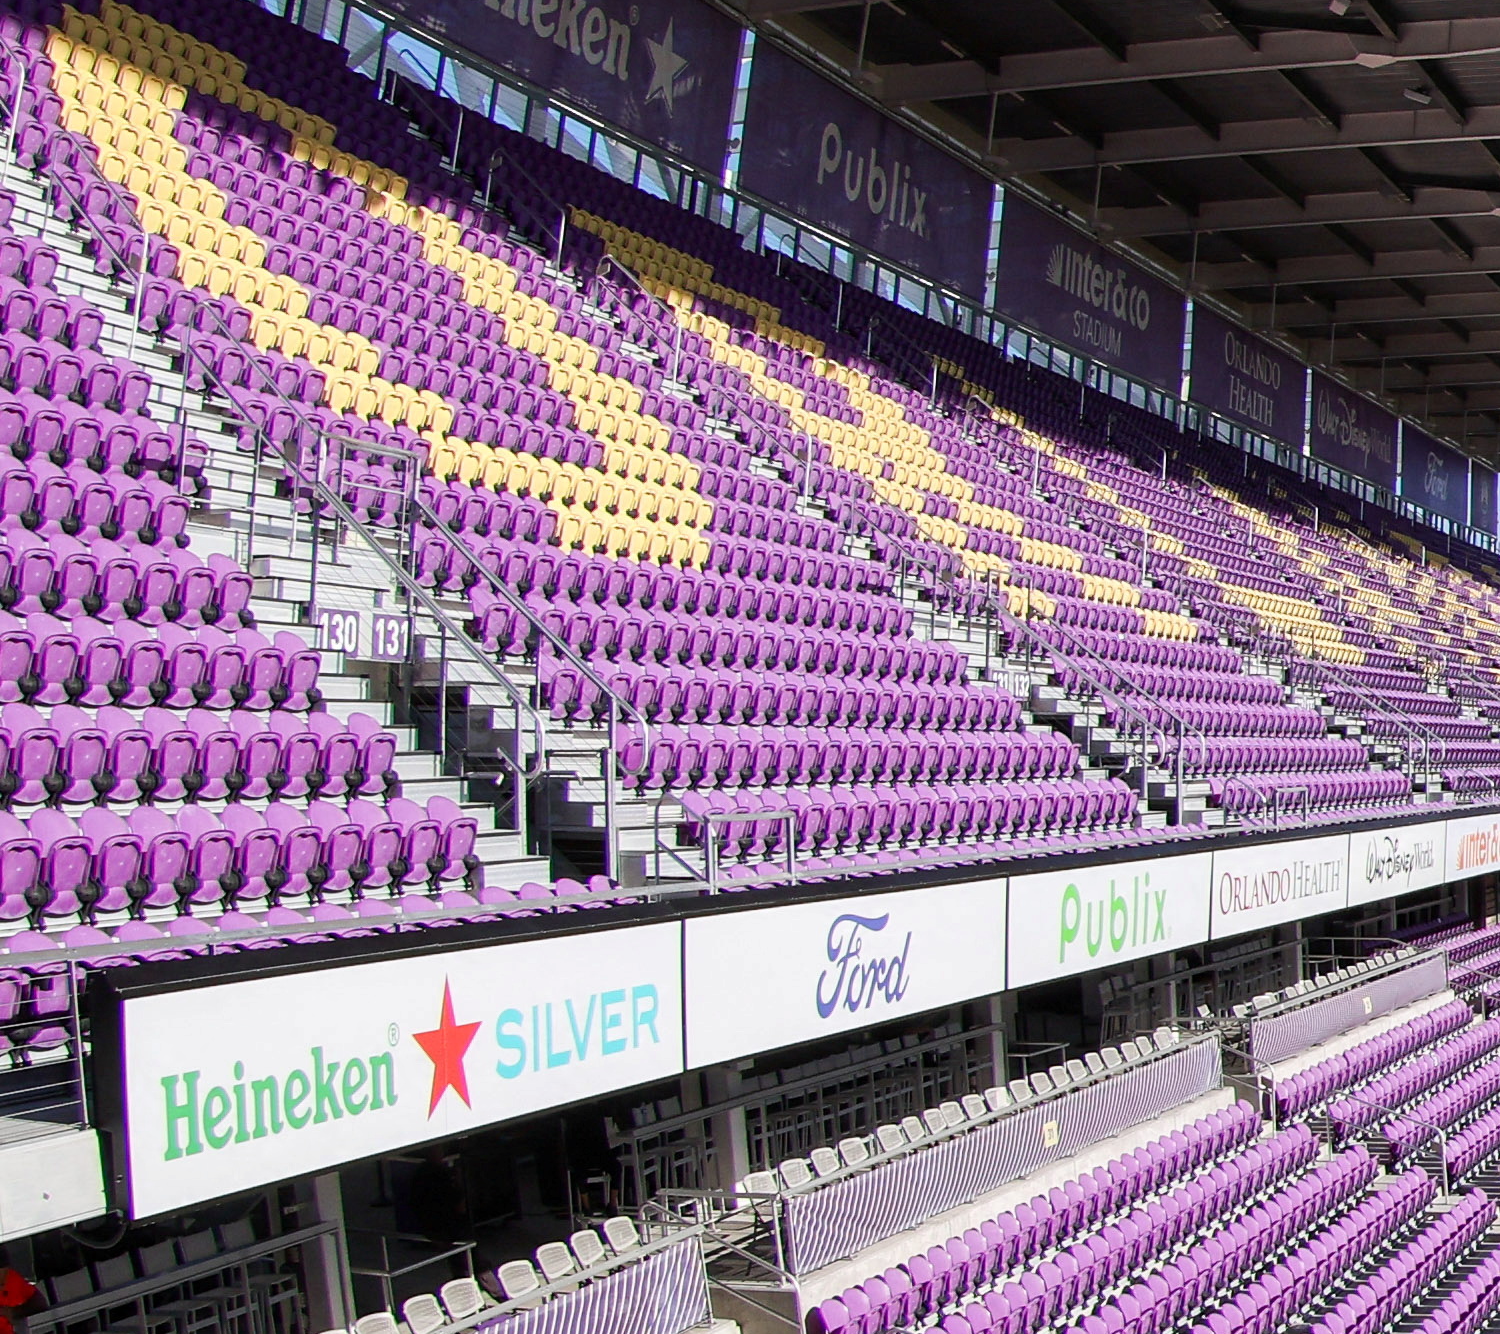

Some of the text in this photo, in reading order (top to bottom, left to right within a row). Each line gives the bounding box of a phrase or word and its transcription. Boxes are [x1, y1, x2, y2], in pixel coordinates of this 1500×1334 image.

[817, 122, 927, 238] Publix
[1073, 309, 1122, 358] STADIUM
[1224, 331, 1281, 392] ORLANDO
[1228, 374, 1274, 428] HEALTH
[1424, 451, 1448, 502] Ford
[1413, 839, 1435, 872] World
[1220, 859, 1341, 915] ORLANDO HEALTH
[1059, 872, 1166, 965] Publix
[816, 912, 912, 1020] Ford
[160, 982, 660, 1162] Heineken SILVER
